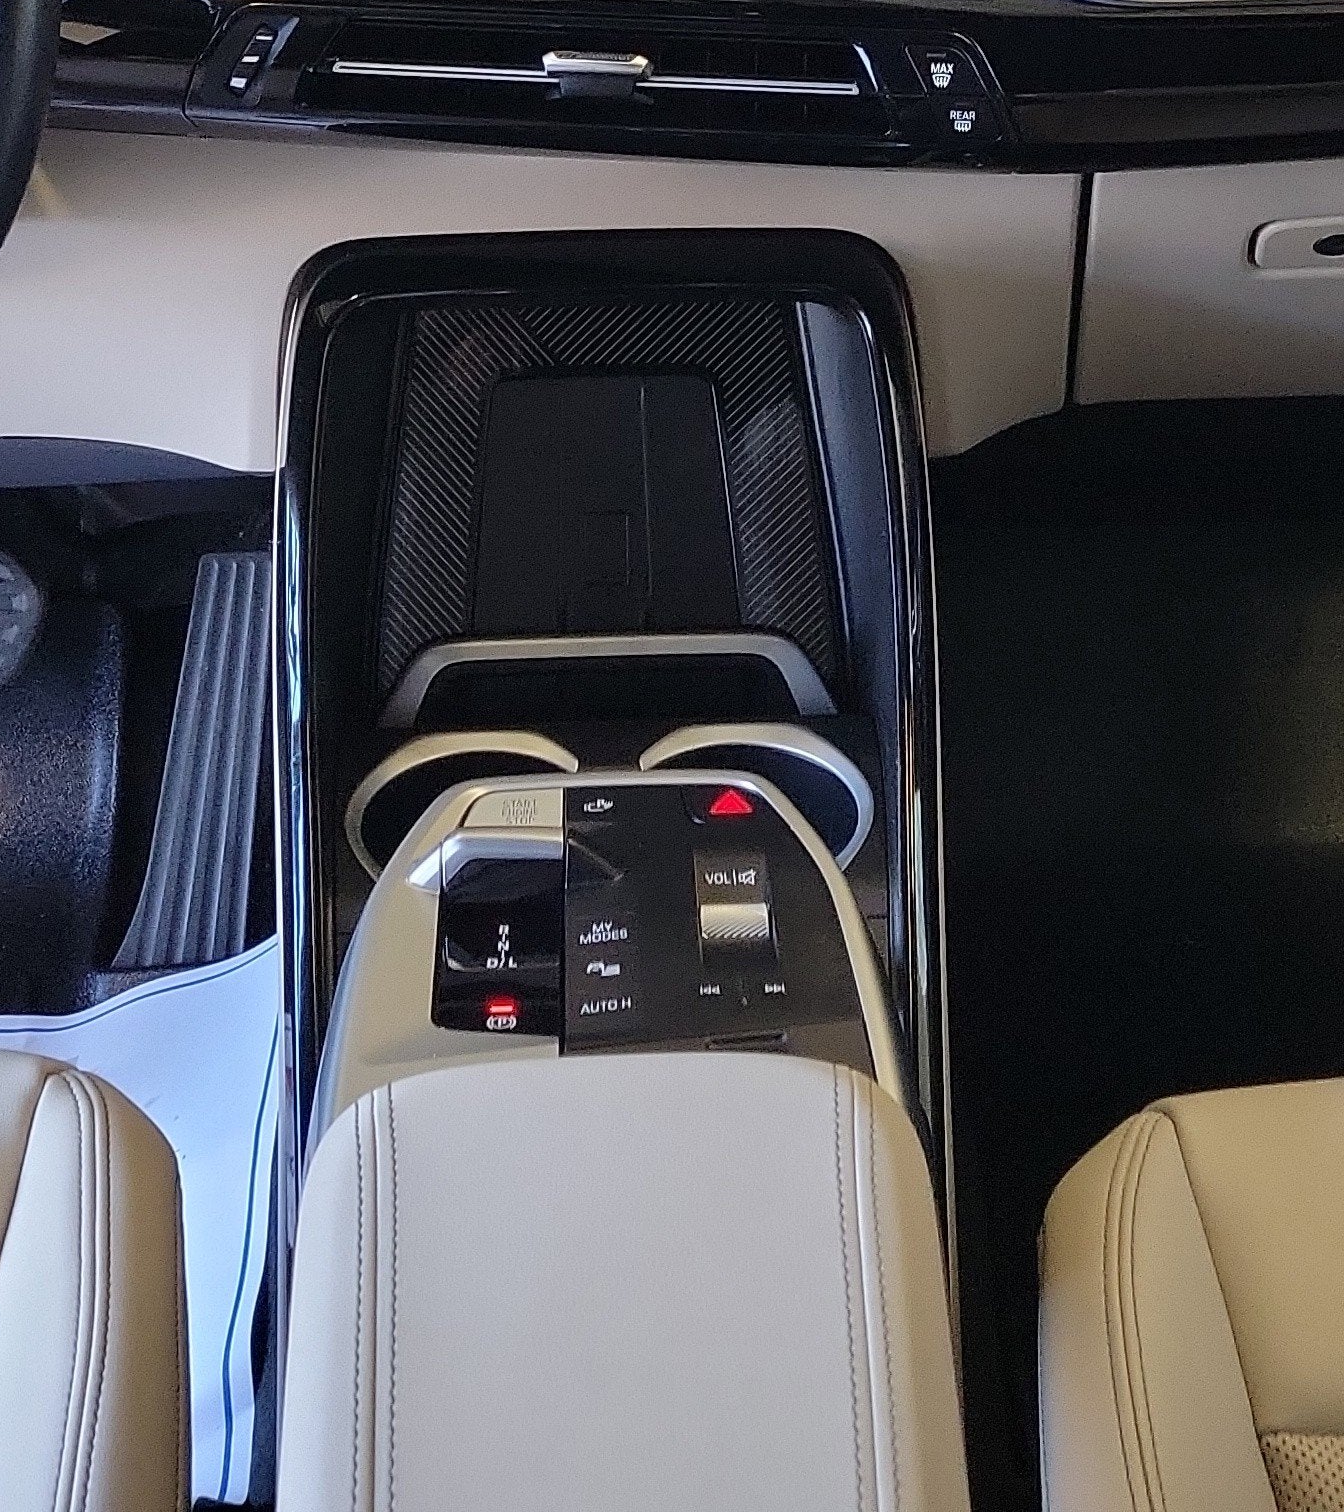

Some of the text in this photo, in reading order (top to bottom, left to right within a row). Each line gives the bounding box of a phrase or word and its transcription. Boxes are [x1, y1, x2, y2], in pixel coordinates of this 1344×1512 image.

[930, 62, 954, 74] MAX
[949, 110, 976, 121] REAR
[704, 871, 732, 885] VOL
[592, 920, 613, 934] MY
[497, 939, 510, 952] N
[579, 995, 632, 1016] AUTO H
